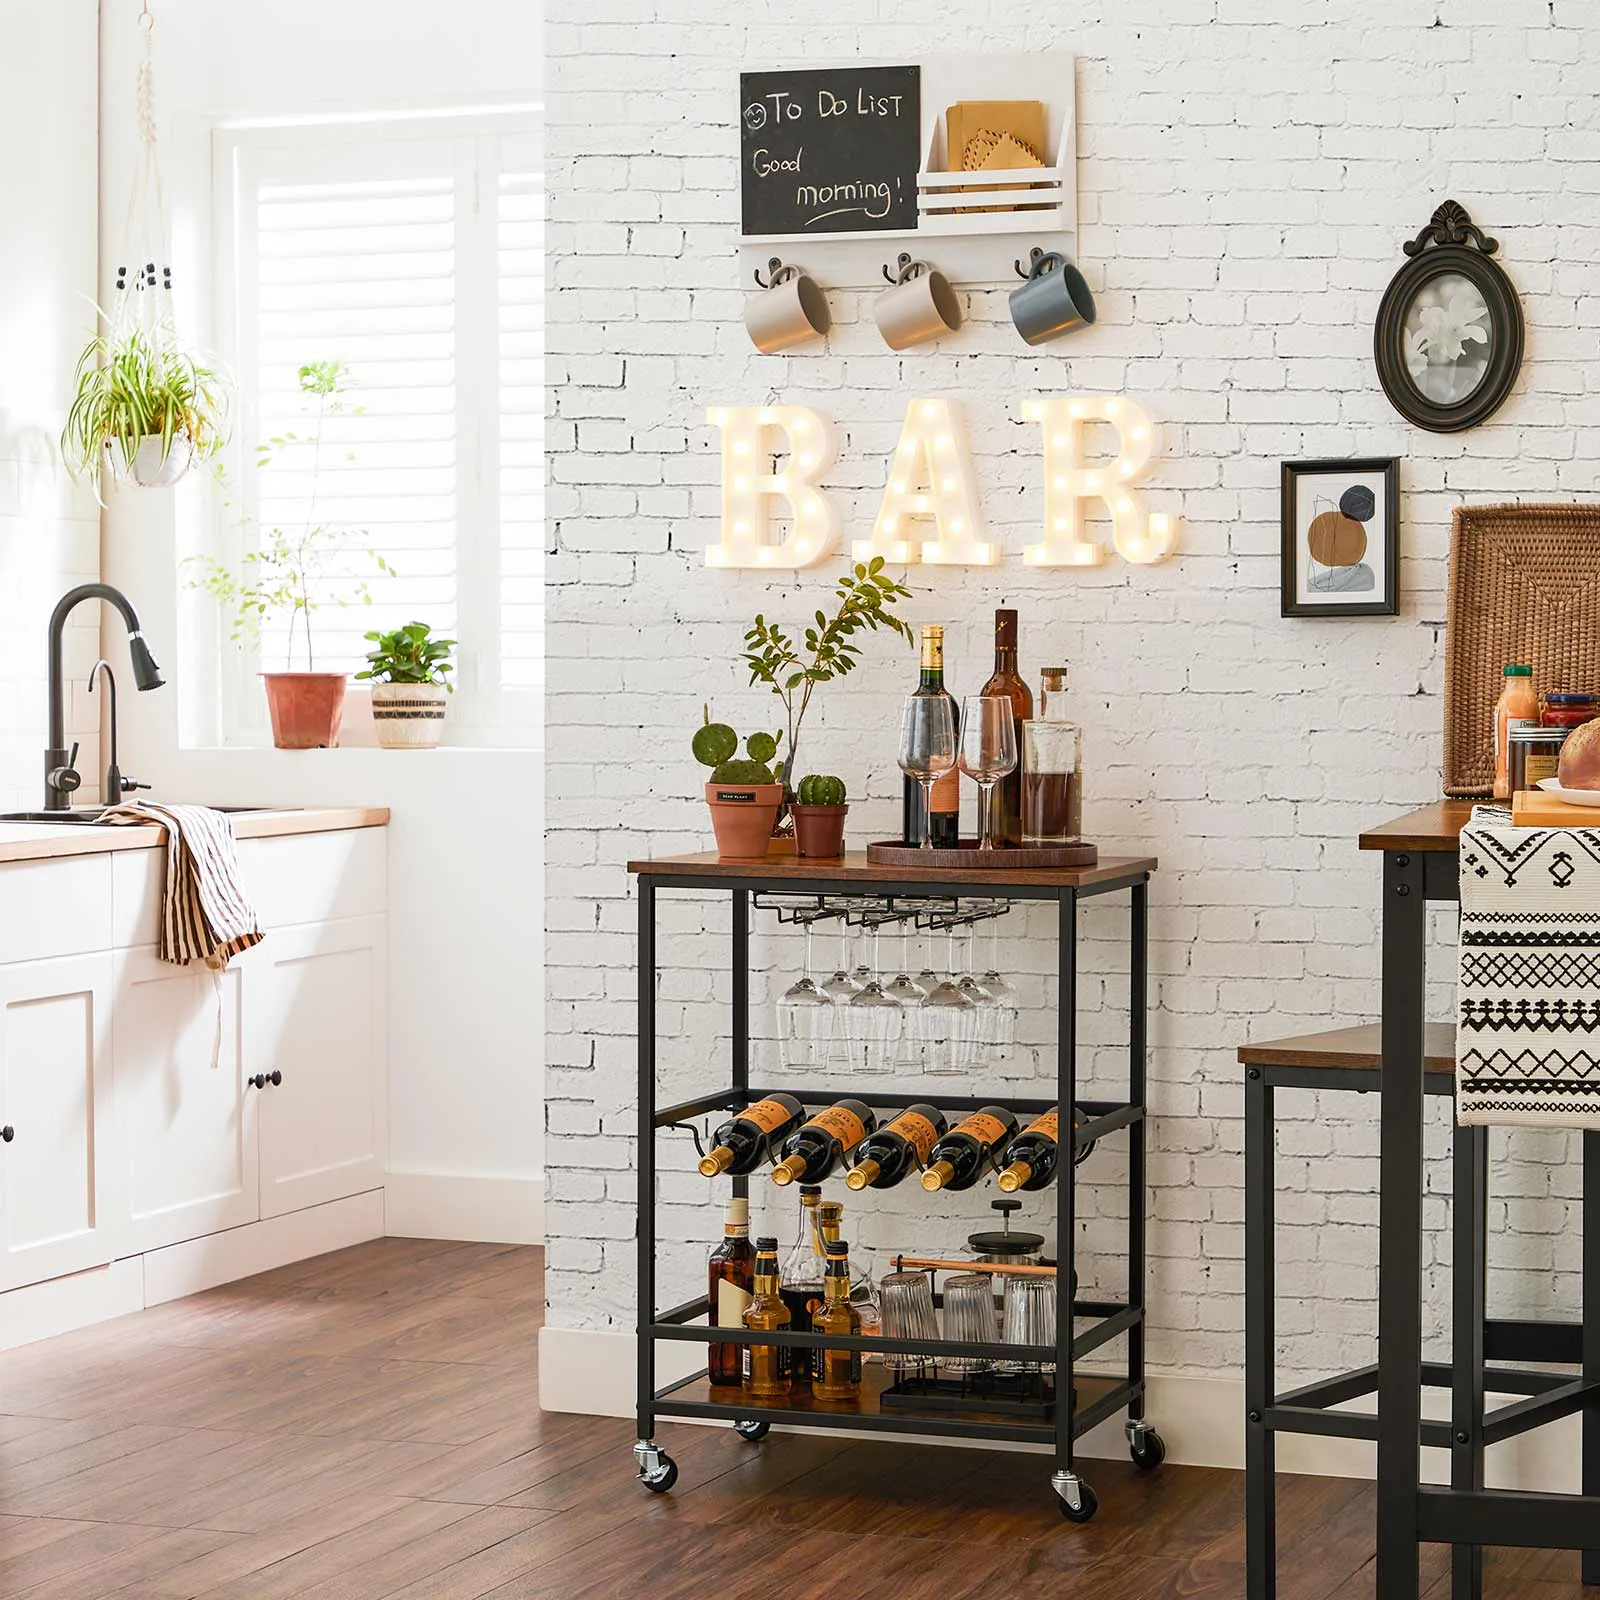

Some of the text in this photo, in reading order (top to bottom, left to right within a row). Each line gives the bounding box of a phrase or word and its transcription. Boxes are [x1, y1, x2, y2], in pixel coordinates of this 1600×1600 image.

[765, 92, 802, 124] To
[818, 90, 848, 118] Do
[753, 146, 803, 178] Good
[704, 396, 1180, 569] BAR
